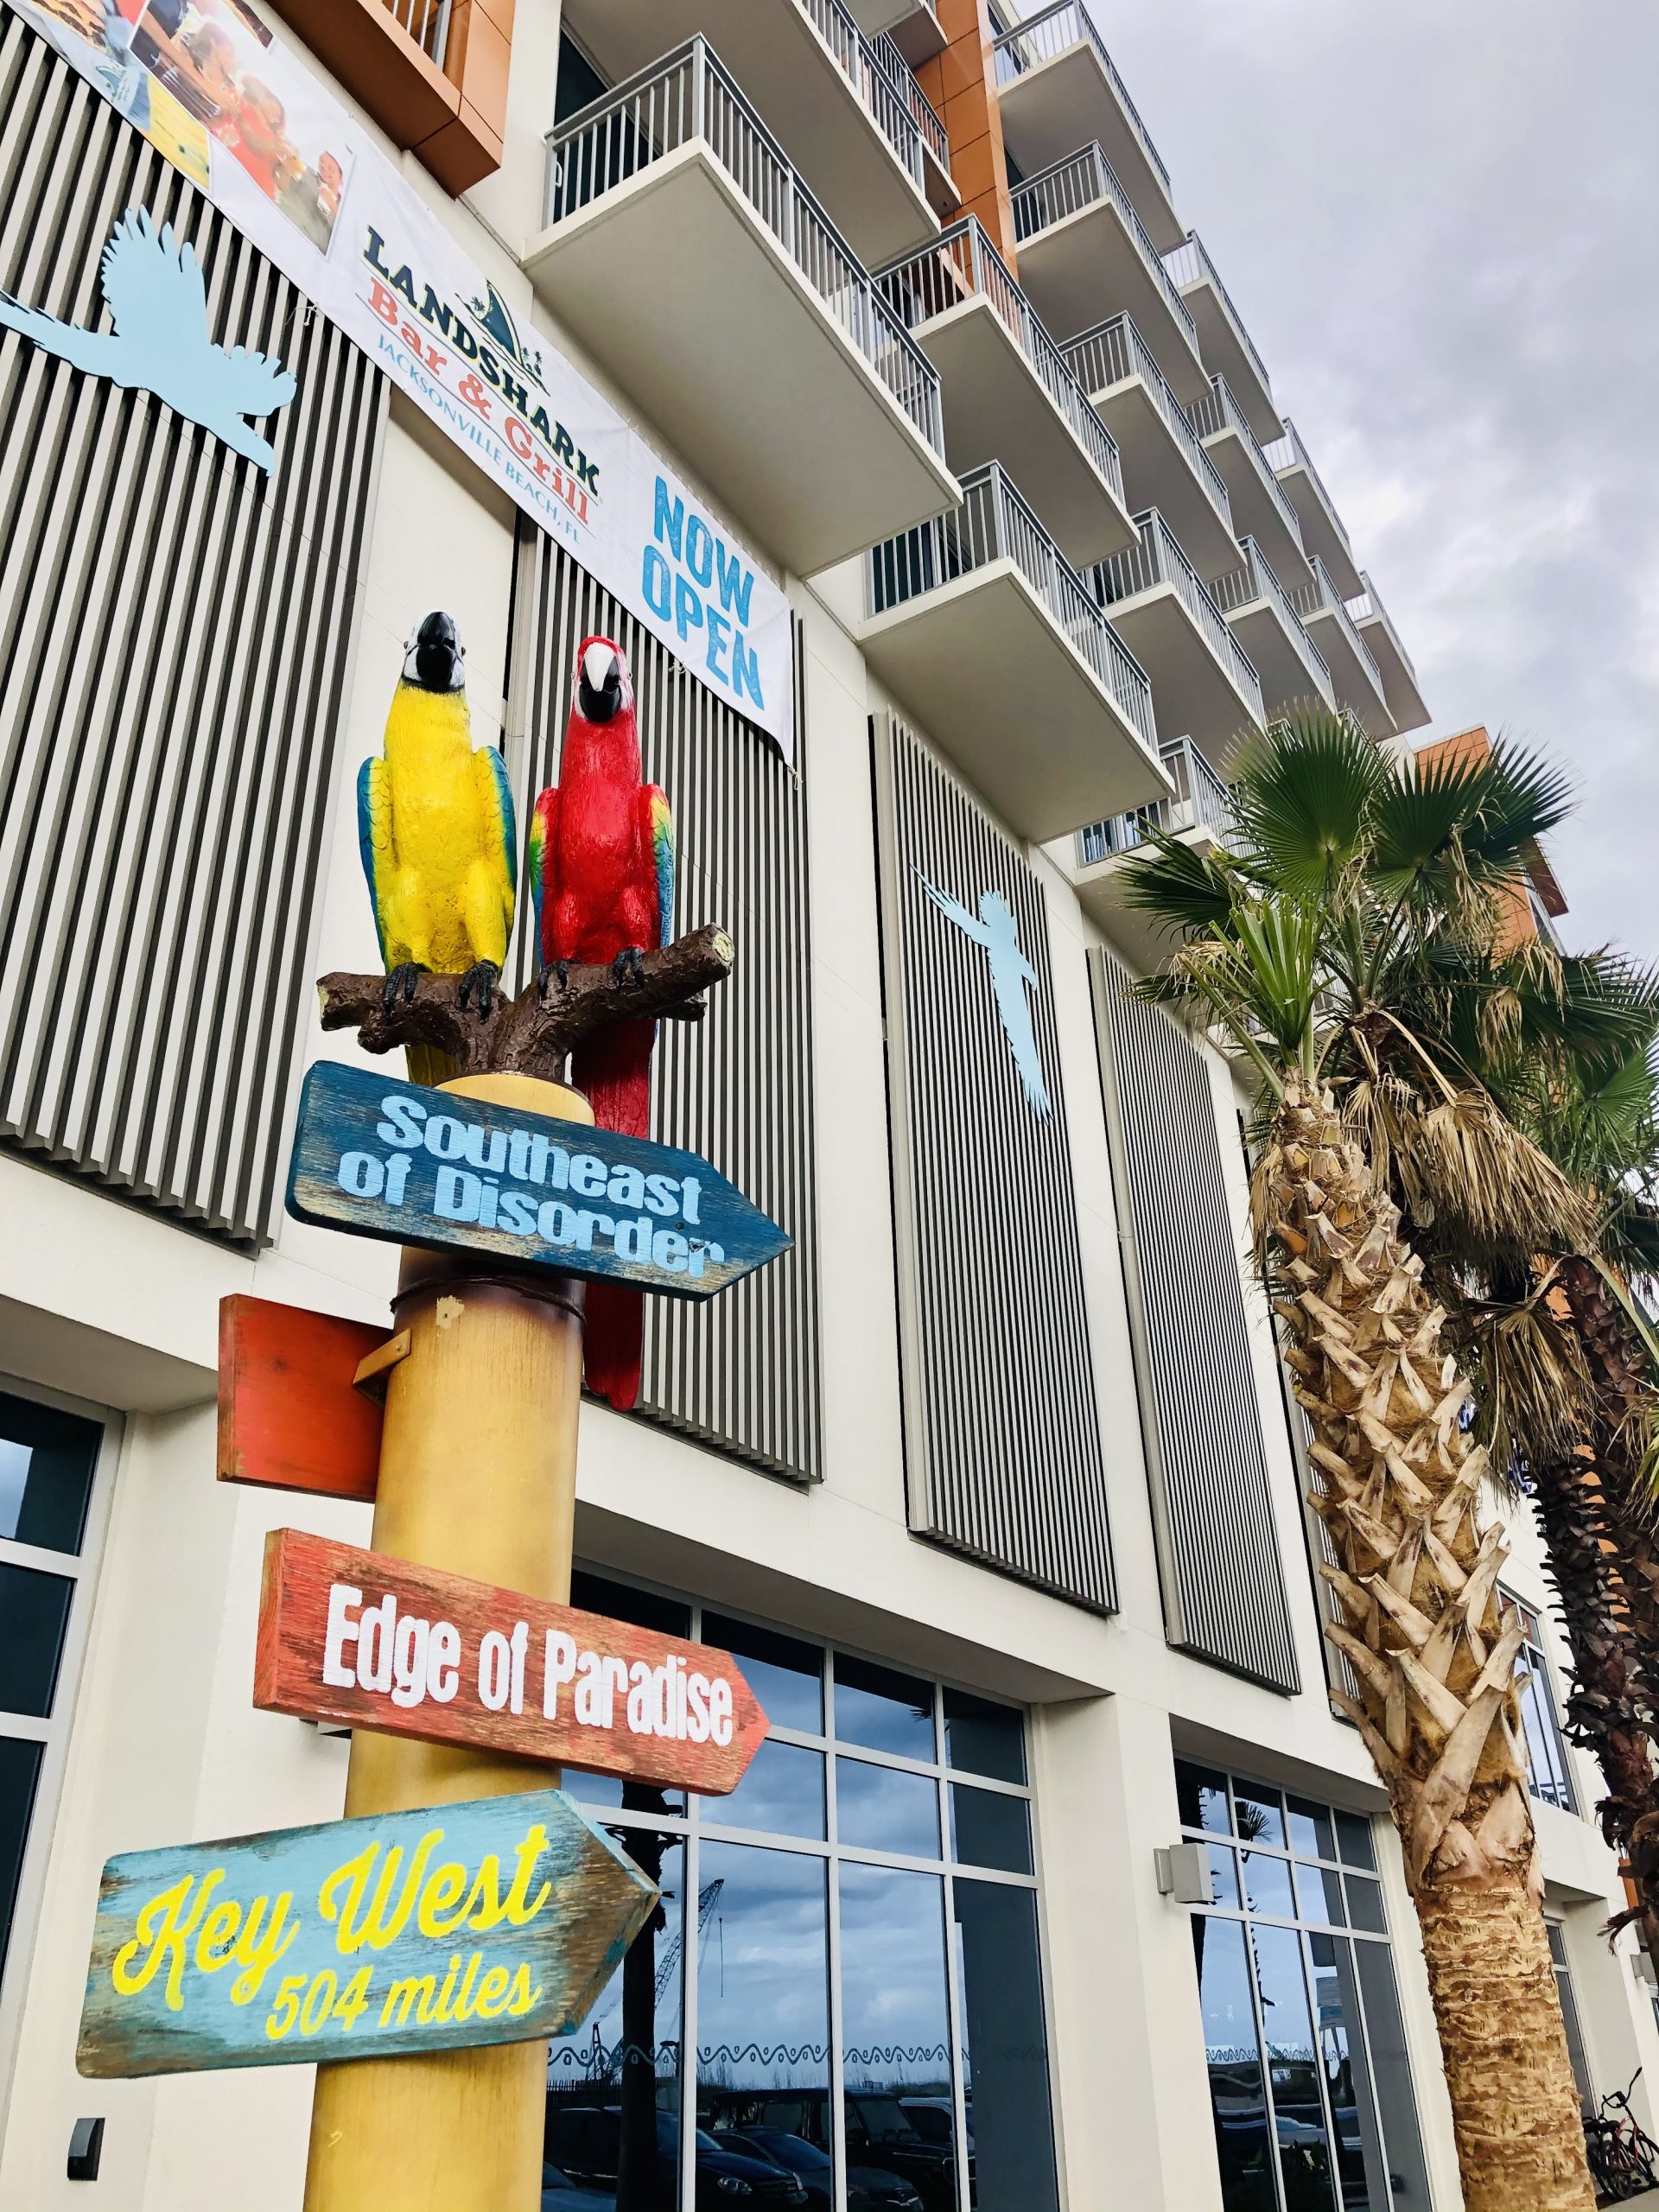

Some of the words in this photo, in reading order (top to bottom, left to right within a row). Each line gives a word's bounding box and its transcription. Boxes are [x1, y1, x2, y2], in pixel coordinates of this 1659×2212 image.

[363, 224, 600, 498] LANDSHARK
[367, 276, 448, 377] Bar
[458, 373, 493, 421] &
[504, 416, 588, 525] Grill
[378, 334, 502, 466] JACKSONVILLE
[565, 520, 581, 545] FL
[642, 543, 766, 711] OPEN
[654, 474, 755, 628] NOW
[337, 1151, 412, 1206] of
[434, 1165, 725, 1279] Disorder
[376, 1095, 702, 1227] Southeast
[322, 1583, 461, 1709] Edge
[478, 1621, 530, 1715] of
[543, 1629, 734, 1746] Paradise
[111, 1867, 301, 2012] Key
[317, 1823, 553, 1955] West
[264, 1965, 375, 2041] 504
[378, 1952, 543, 2029] miles
